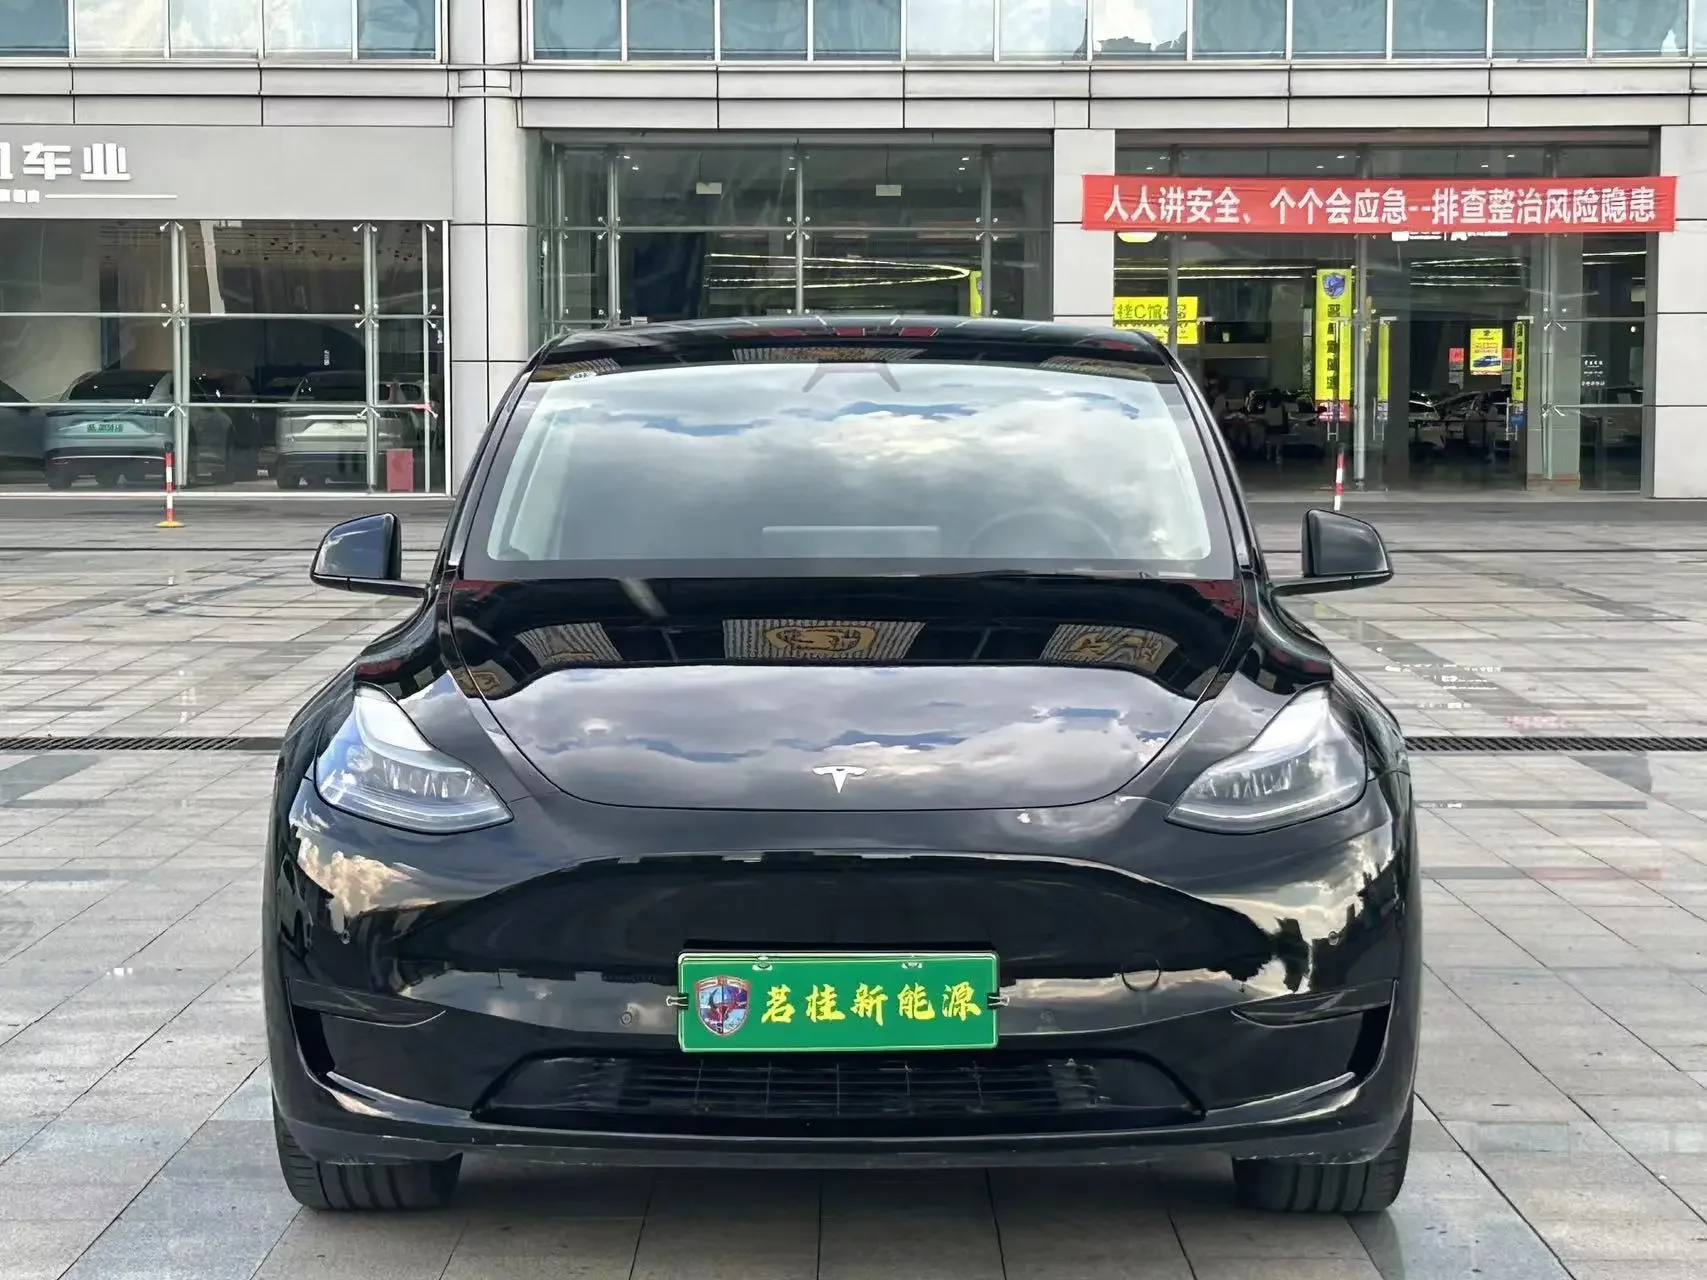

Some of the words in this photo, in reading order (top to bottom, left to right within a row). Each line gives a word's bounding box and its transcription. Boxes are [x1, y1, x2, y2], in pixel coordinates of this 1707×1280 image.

[760, 981, 982, 1026] 茗桂新能源
